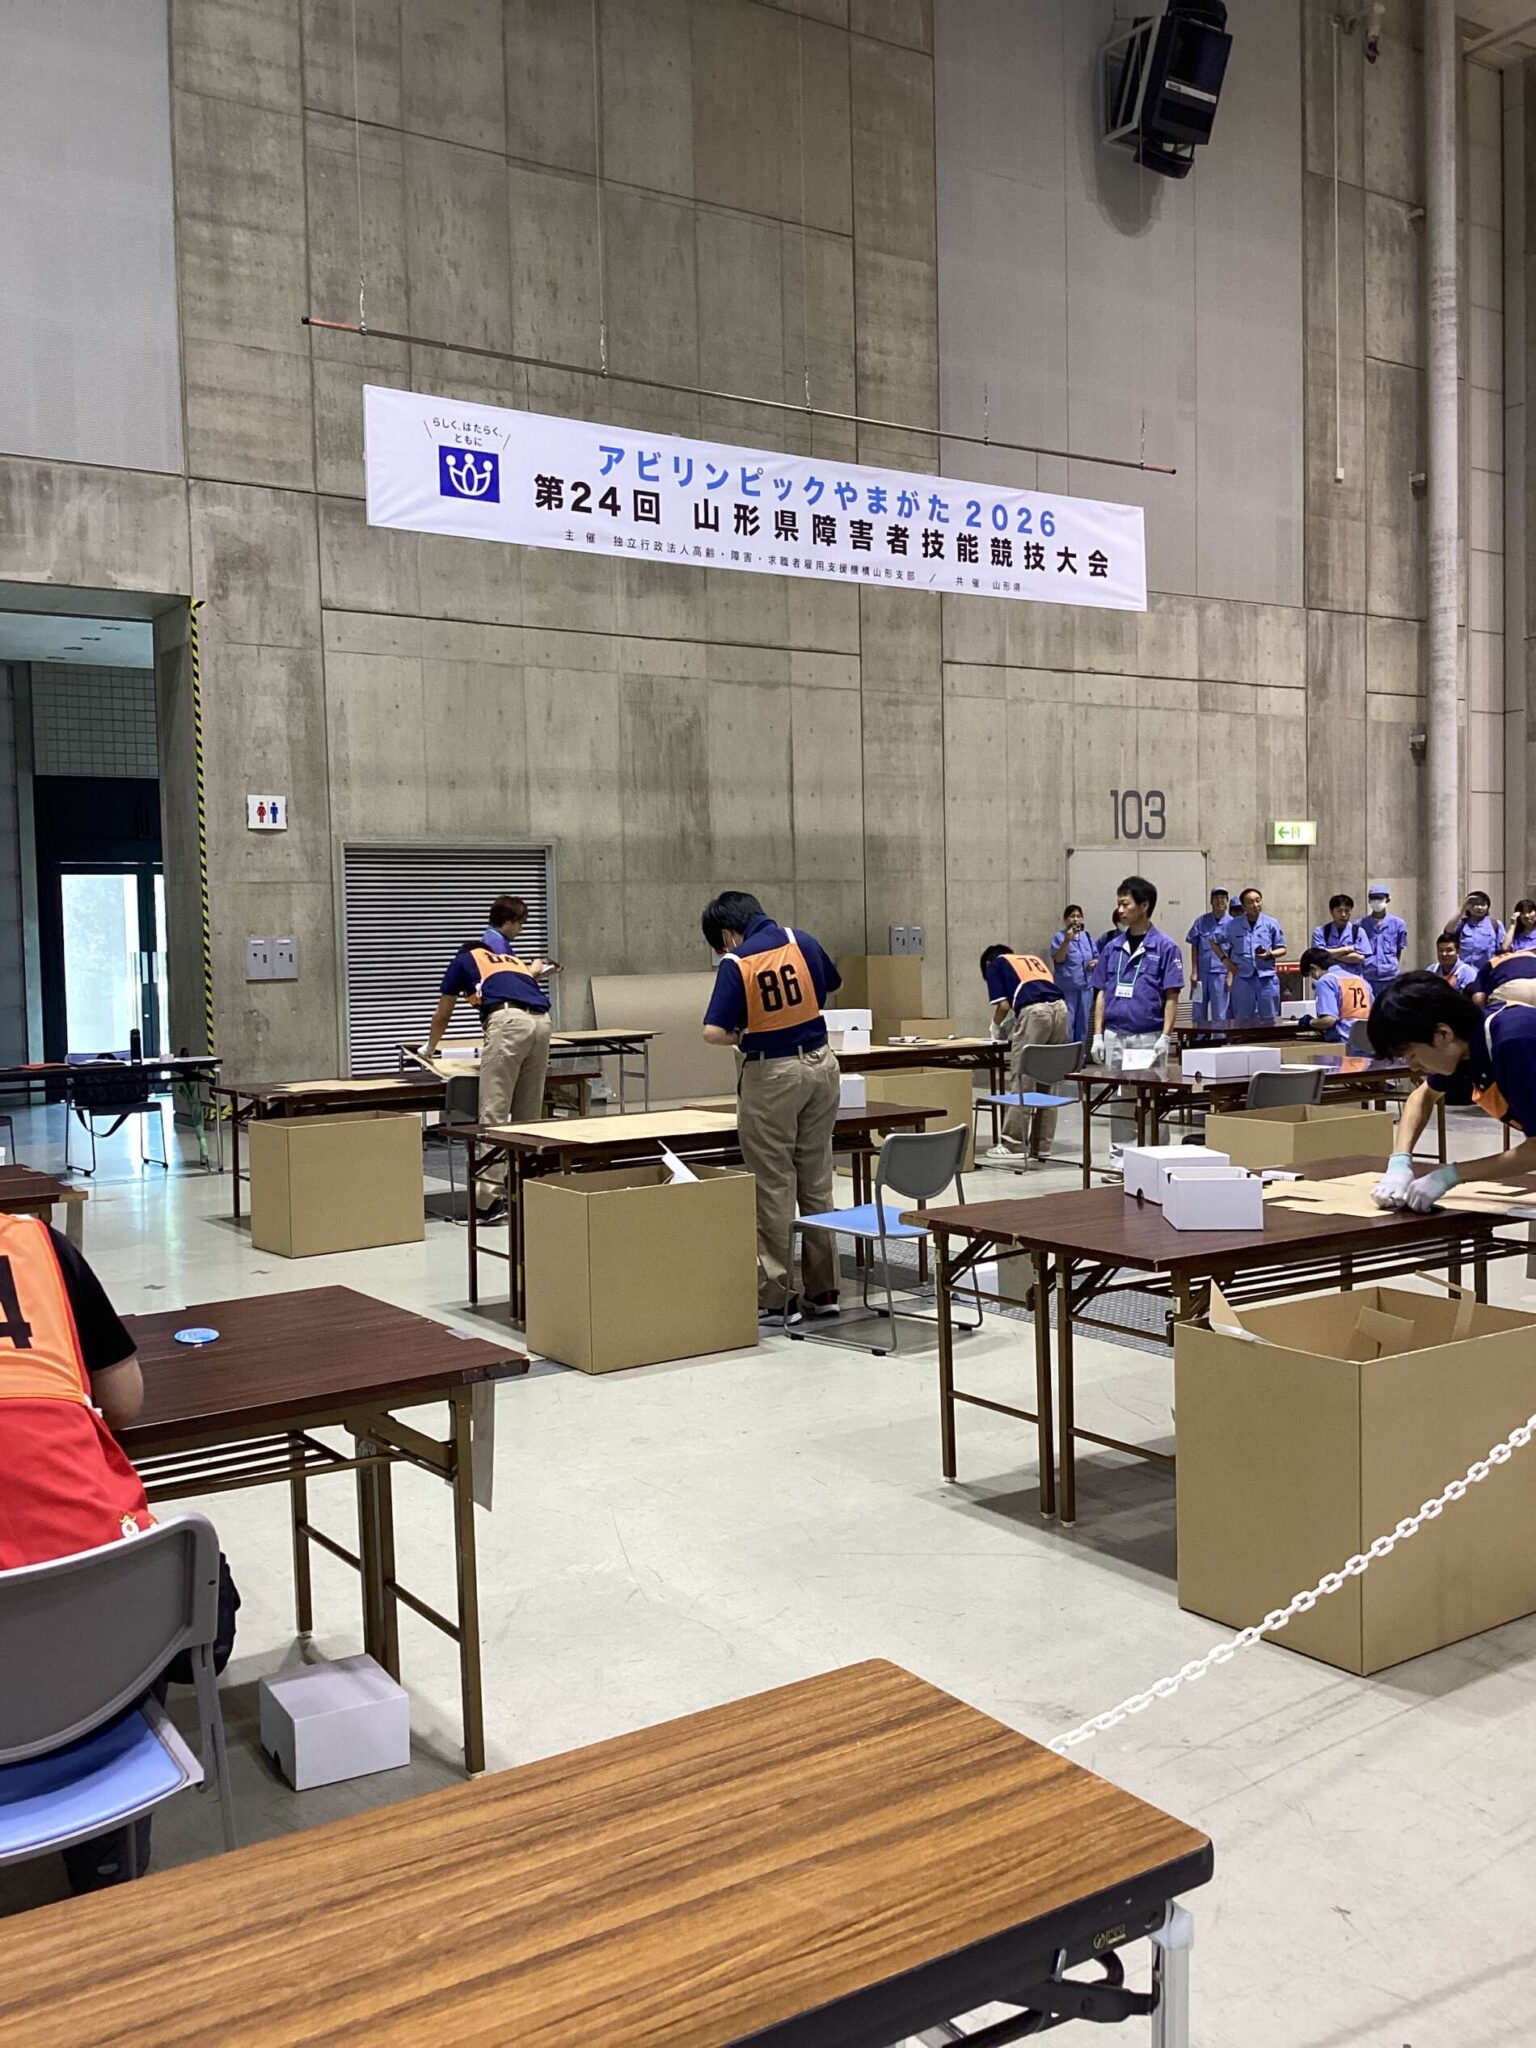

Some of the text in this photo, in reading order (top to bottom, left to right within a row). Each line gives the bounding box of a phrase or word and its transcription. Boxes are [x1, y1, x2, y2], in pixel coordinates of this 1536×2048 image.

[454, 433, 483, 447] ともに
[598, 444, 1057, 538] アビリンピックやまがた 2026
[534, 474, 1110, 579] 第24回 山形県障害者技能競技大会
[1110, 789, 1166, 840] 103
[759, 964, 805, 1012] 86
[1016, 957, 1048, 974] 78
[1347, 986, 1368, 1010] 72
